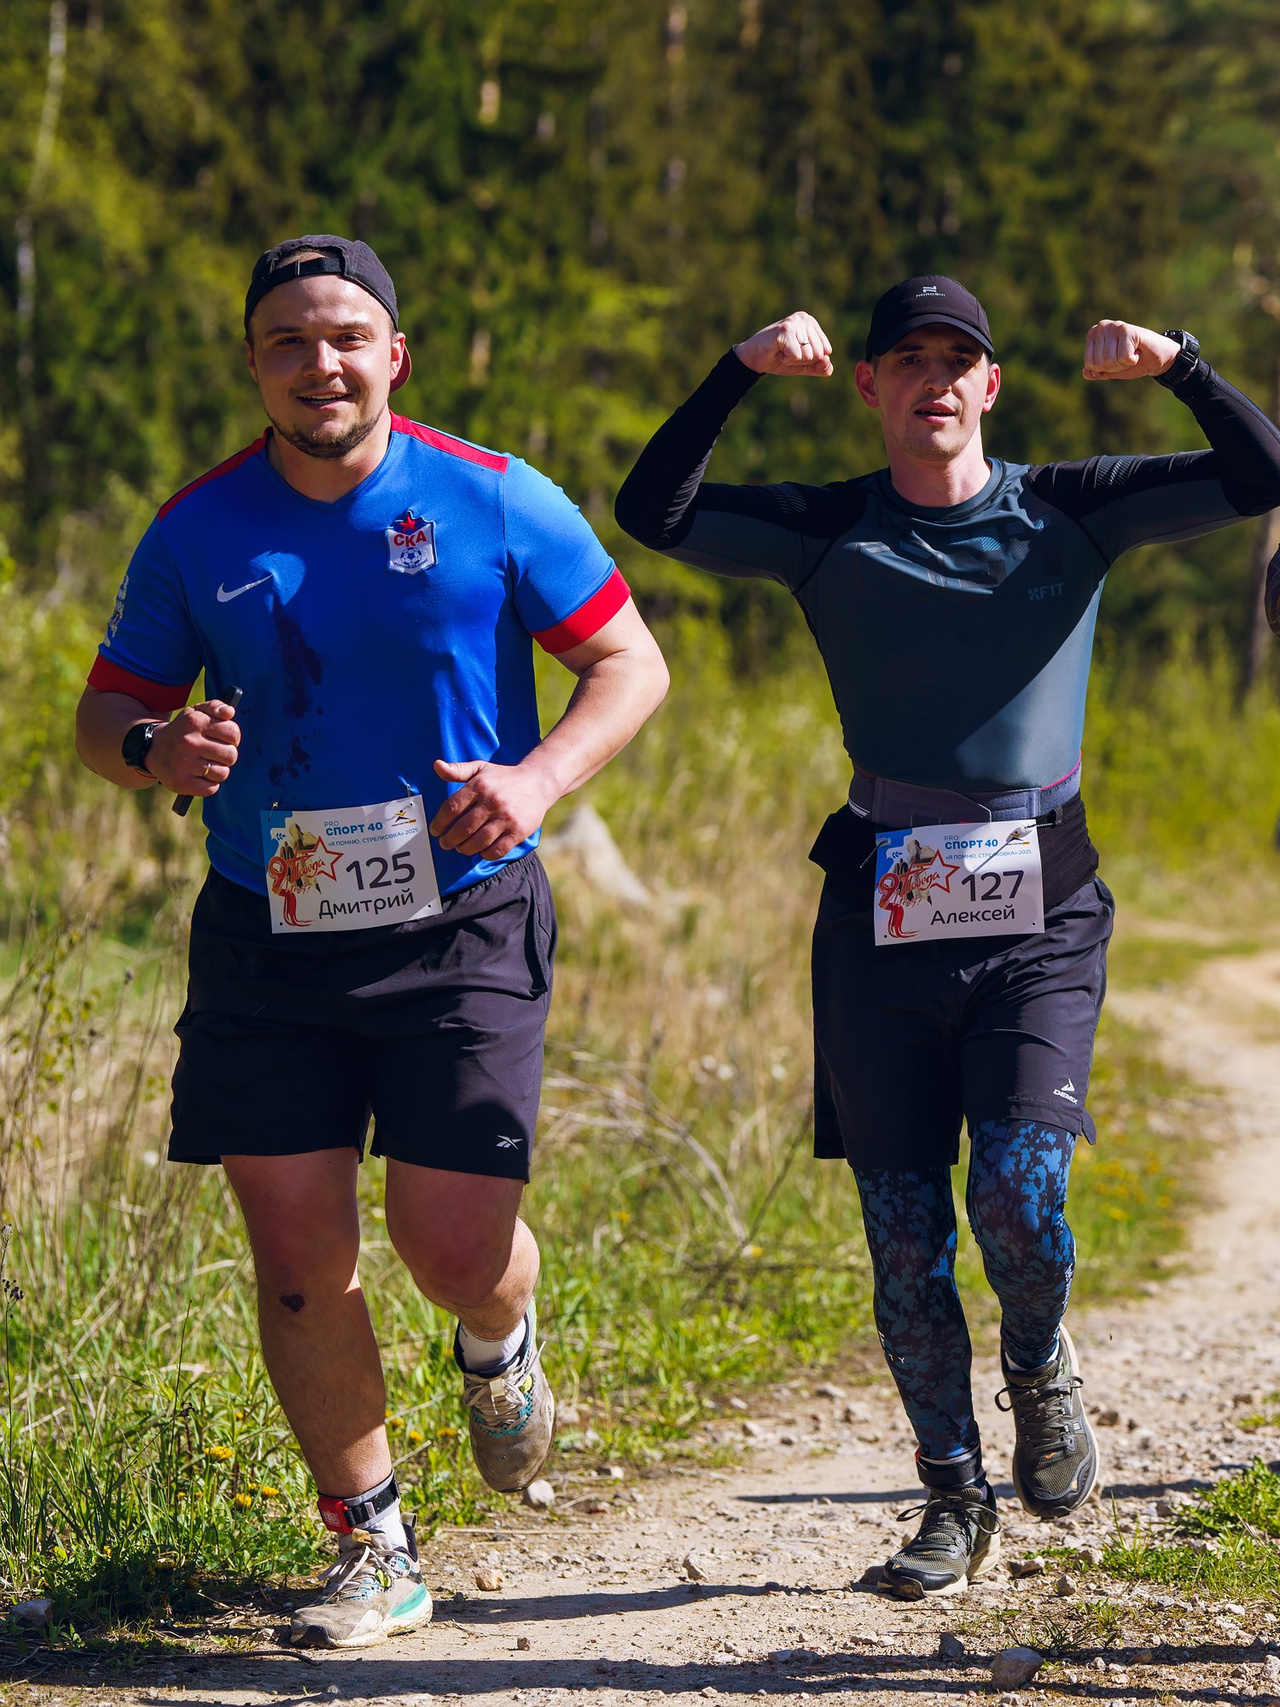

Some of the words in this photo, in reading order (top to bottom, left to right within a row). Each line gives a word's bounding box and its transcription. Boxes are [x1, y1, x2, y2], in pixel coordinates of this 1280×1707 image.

[393, 530, 427, 548] СКА
[324, 820, 340, 828] PRO
[326, 824, 365, 836] СПОРТ
[368, 822, 383, 832] 40
[405, 828, 419, 836] 2025
[945, 840, 983, 850] СПОРТ
[986, 839, 998, 848] 40
[346, 851, 416, 891] 125
[961, 870, 1024, 902] 127
[318, 887, 414, 920] Дмитрий
[930, 904, 1016, 926] Алексей
